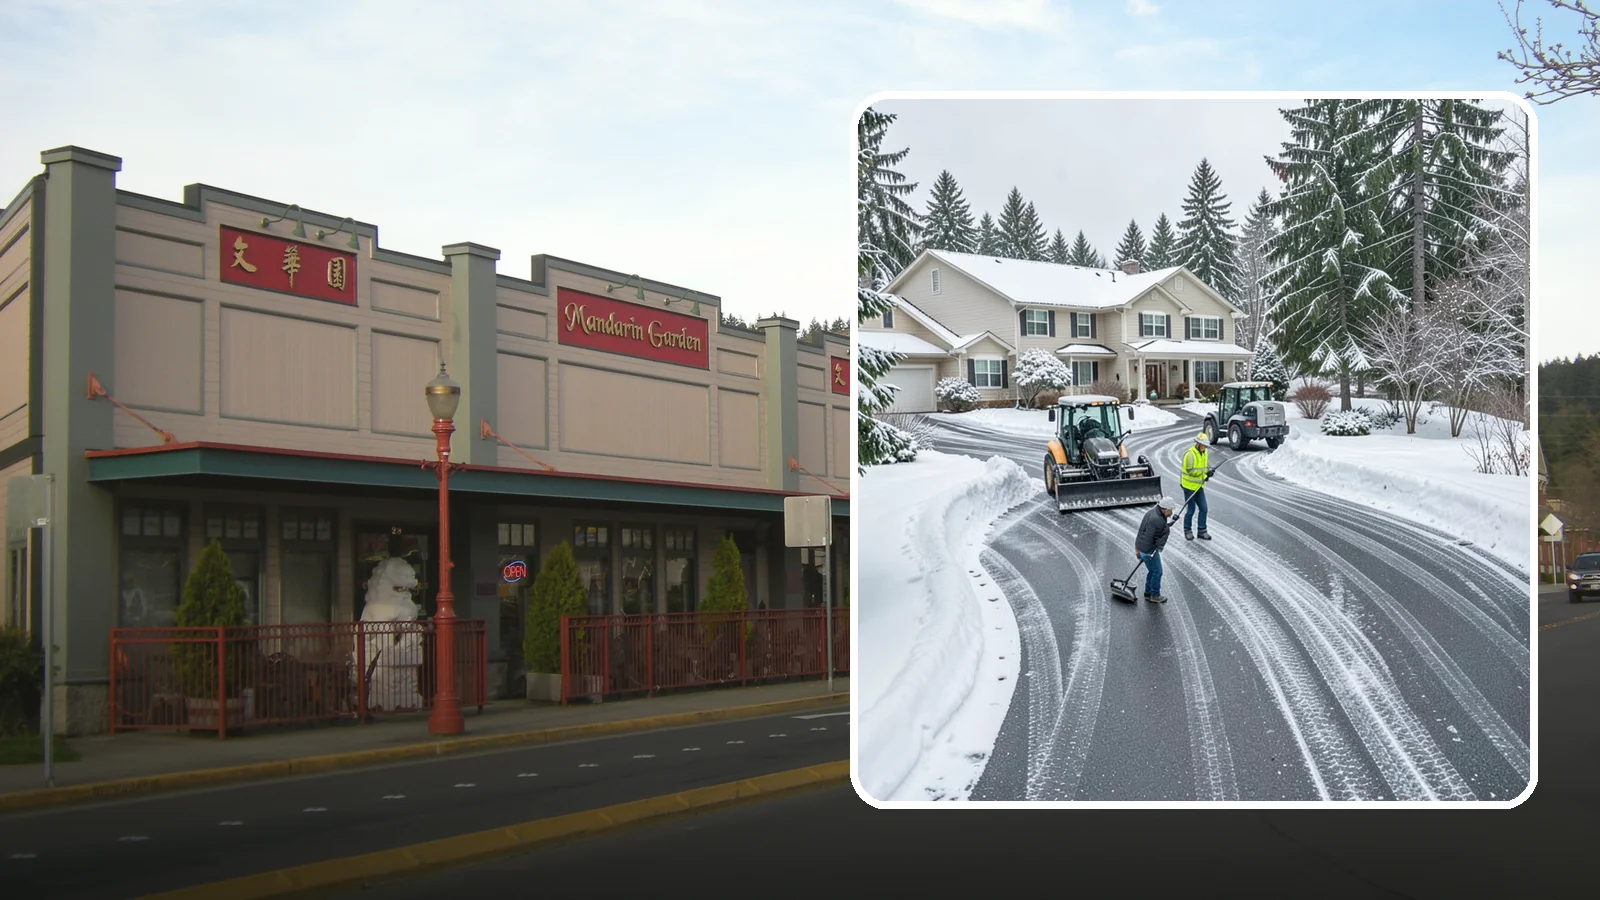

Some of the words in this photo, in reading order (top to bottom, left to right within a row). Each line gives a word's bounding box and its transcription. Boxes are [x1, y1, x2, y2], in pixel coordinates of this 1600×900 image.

[230, 235, 346, 291] 文華園
[564, 302, 644, 341] Mandarin
[648, 320, 702, 352] Garden
[503, 565, 527, 578] OPEN
